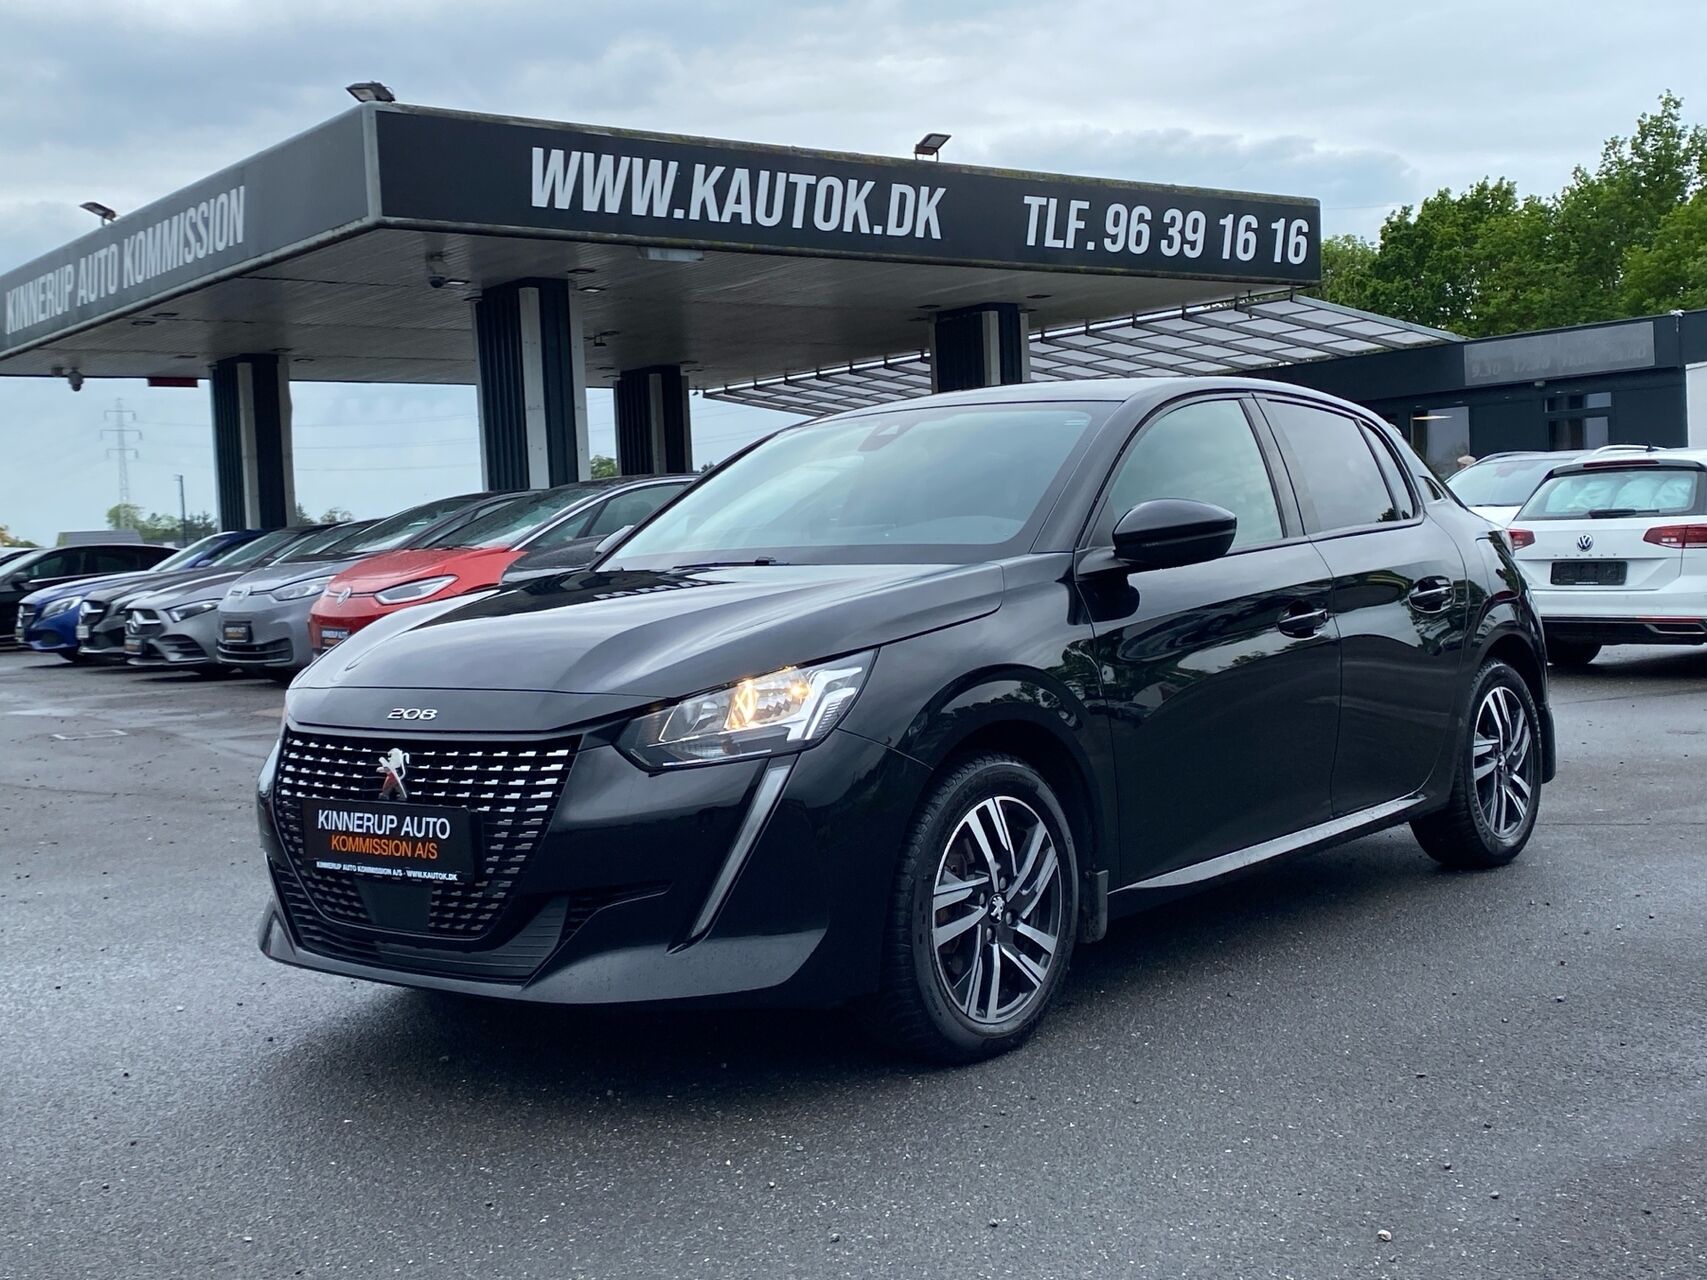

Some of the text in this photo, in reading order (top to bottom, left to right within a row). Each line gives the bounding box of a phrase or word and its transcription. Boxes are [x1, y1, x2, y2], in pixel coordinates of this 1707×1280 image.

[531, 147, 947, 240] WWW.KAUTOK.DK
[1024, 195, 1309, 265] TLF. 96 39 16 16
[6, 185, 245, 335] KINNERUP AUTO KOMMISSION
[387, 707, 438, 720] 208
[317, 809, 450, 840] KINNERUP AUTO
[331, 835, 438, 859] KOMMISSION A/S
[316, 861, 342, 870] KINNERUP
[342, 864, 357, 872] AUTO
[357, 865, 391, 875] KOMMISSION
